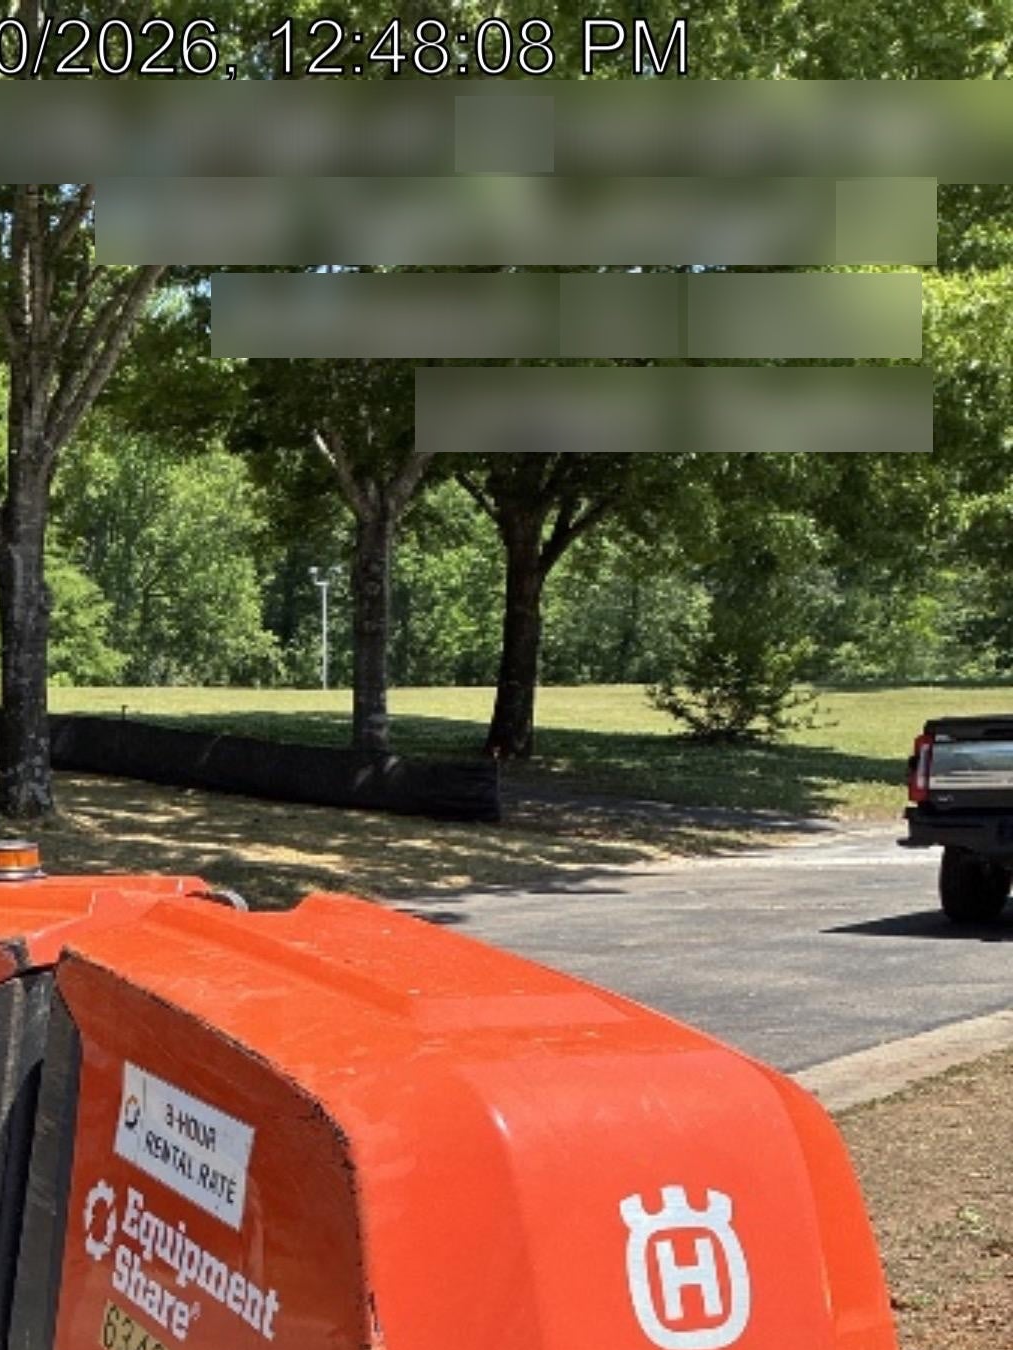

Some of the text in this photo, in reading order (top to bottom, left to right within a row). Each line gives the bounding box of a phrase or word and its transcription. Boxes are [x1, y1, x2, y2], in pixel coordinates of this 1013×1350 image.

[146, 1131, 238, 1205] RENTAL RATE
[120, 1186, 280, 1341] Equipment
